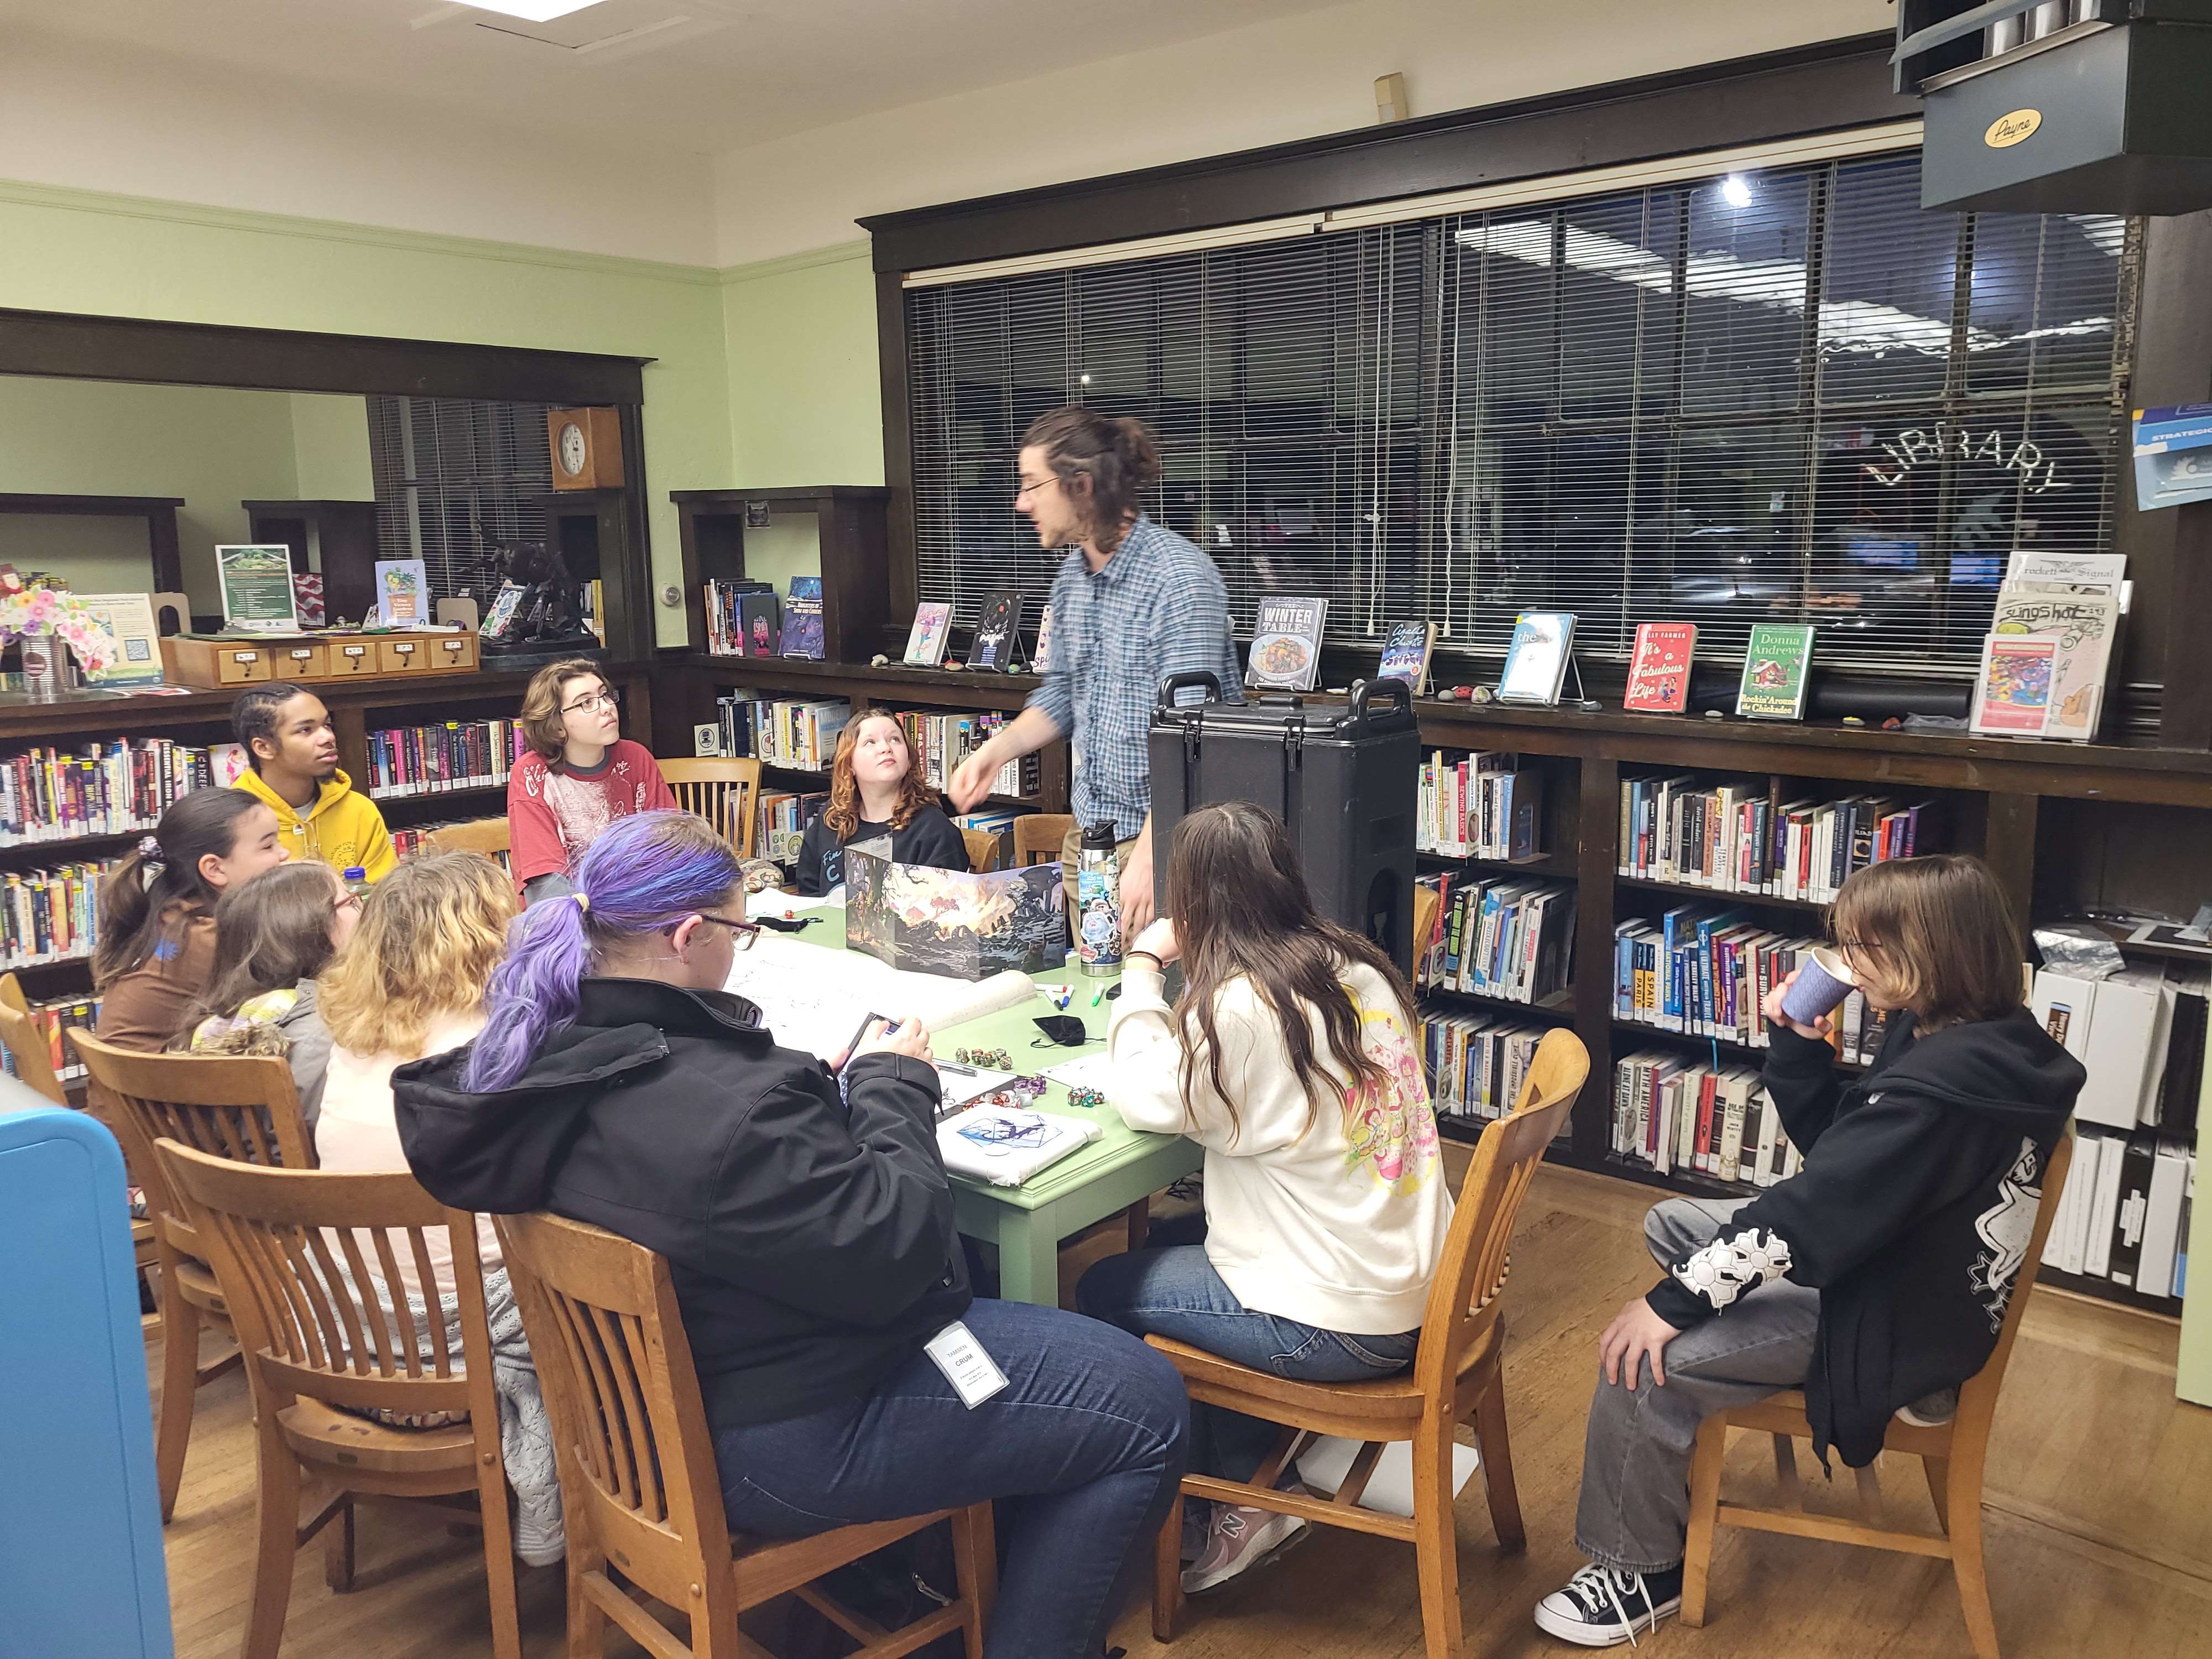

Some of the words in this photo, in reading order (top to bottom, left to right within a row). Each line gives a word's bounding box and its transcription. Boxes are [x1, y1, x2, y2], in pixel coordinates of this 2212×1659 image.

[1994, 119, 2031, 140] Payne
[2077, 567, 2114, 580] Signal
[1265, 608, 1313, 624] WINTER
[1262, 622, 1302, 633] TABLE
[1392, 624, 1425, 638] Agatha
[1390, 635, 1424, 647] Christie
[1517, 631, 1536, 642] the
[1761, 634, 1799, 645] Donna
[1640, 642, 1661, 656] It's
[1753, 645, 1804, 655] Andrews
[1632, 663, 1684, 677] Fabulous
[1629, 682, 1655, 699] Life
[163, 747, 171, 779] ESSENTIAL
[1701, 956, 1709, 980] ULTIMATE
[1623, 1067, 1631, 1084] ALONE
[1642, 1066, 1651, 1087] MYTH
[1640, 1090, 1650, 1121] AMERICA
[947, 1344, 967, 1358] TAMSEN
[956, 1353, 973, 1366] CRUM
